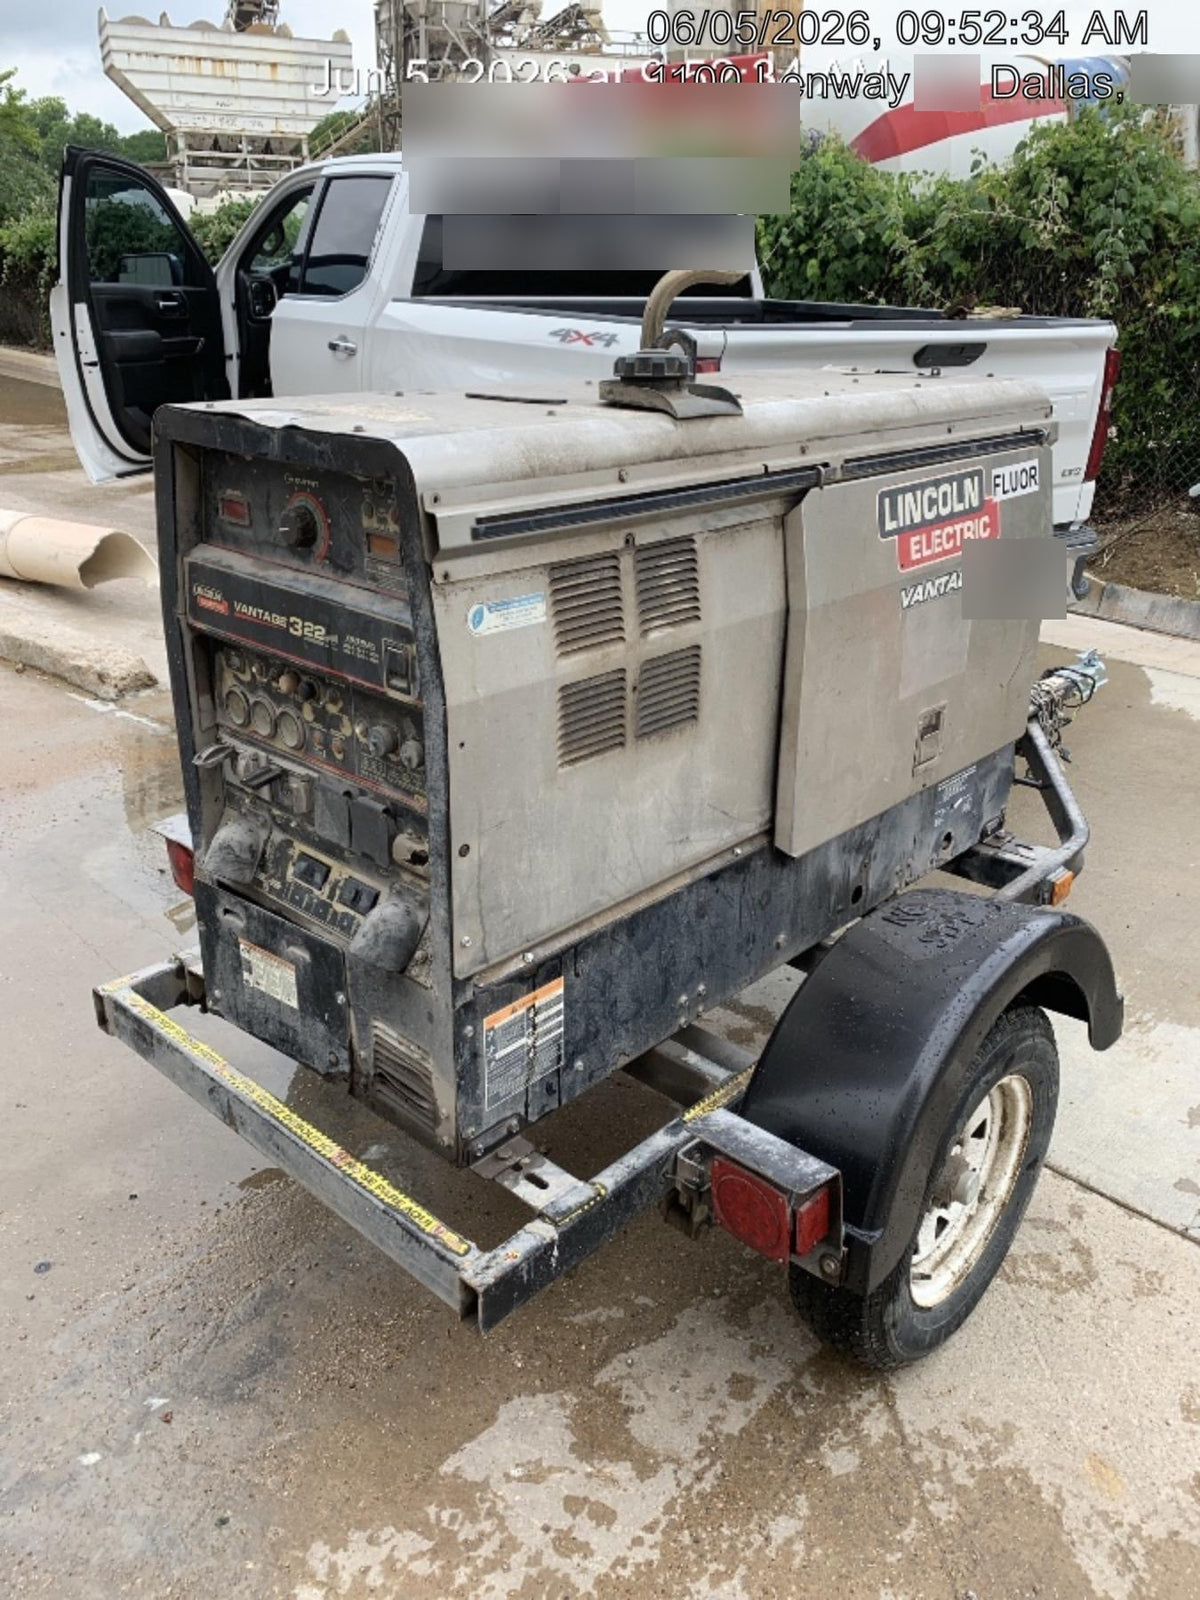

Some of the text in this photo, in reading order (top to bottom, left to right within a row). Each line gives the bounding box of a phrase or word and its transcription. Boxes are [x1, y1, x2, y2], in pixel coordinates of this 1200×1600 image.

[993, 465, 1038, 496] FLUOR
[884, 475, 979, 531] LINCOLN
[909, 515, 990, 561] ELECTRIC
[901, 571, 962, 609] VANTA
[234, 600, 287, 628] VANTAGE
[289, 616, 325, 641] 322
